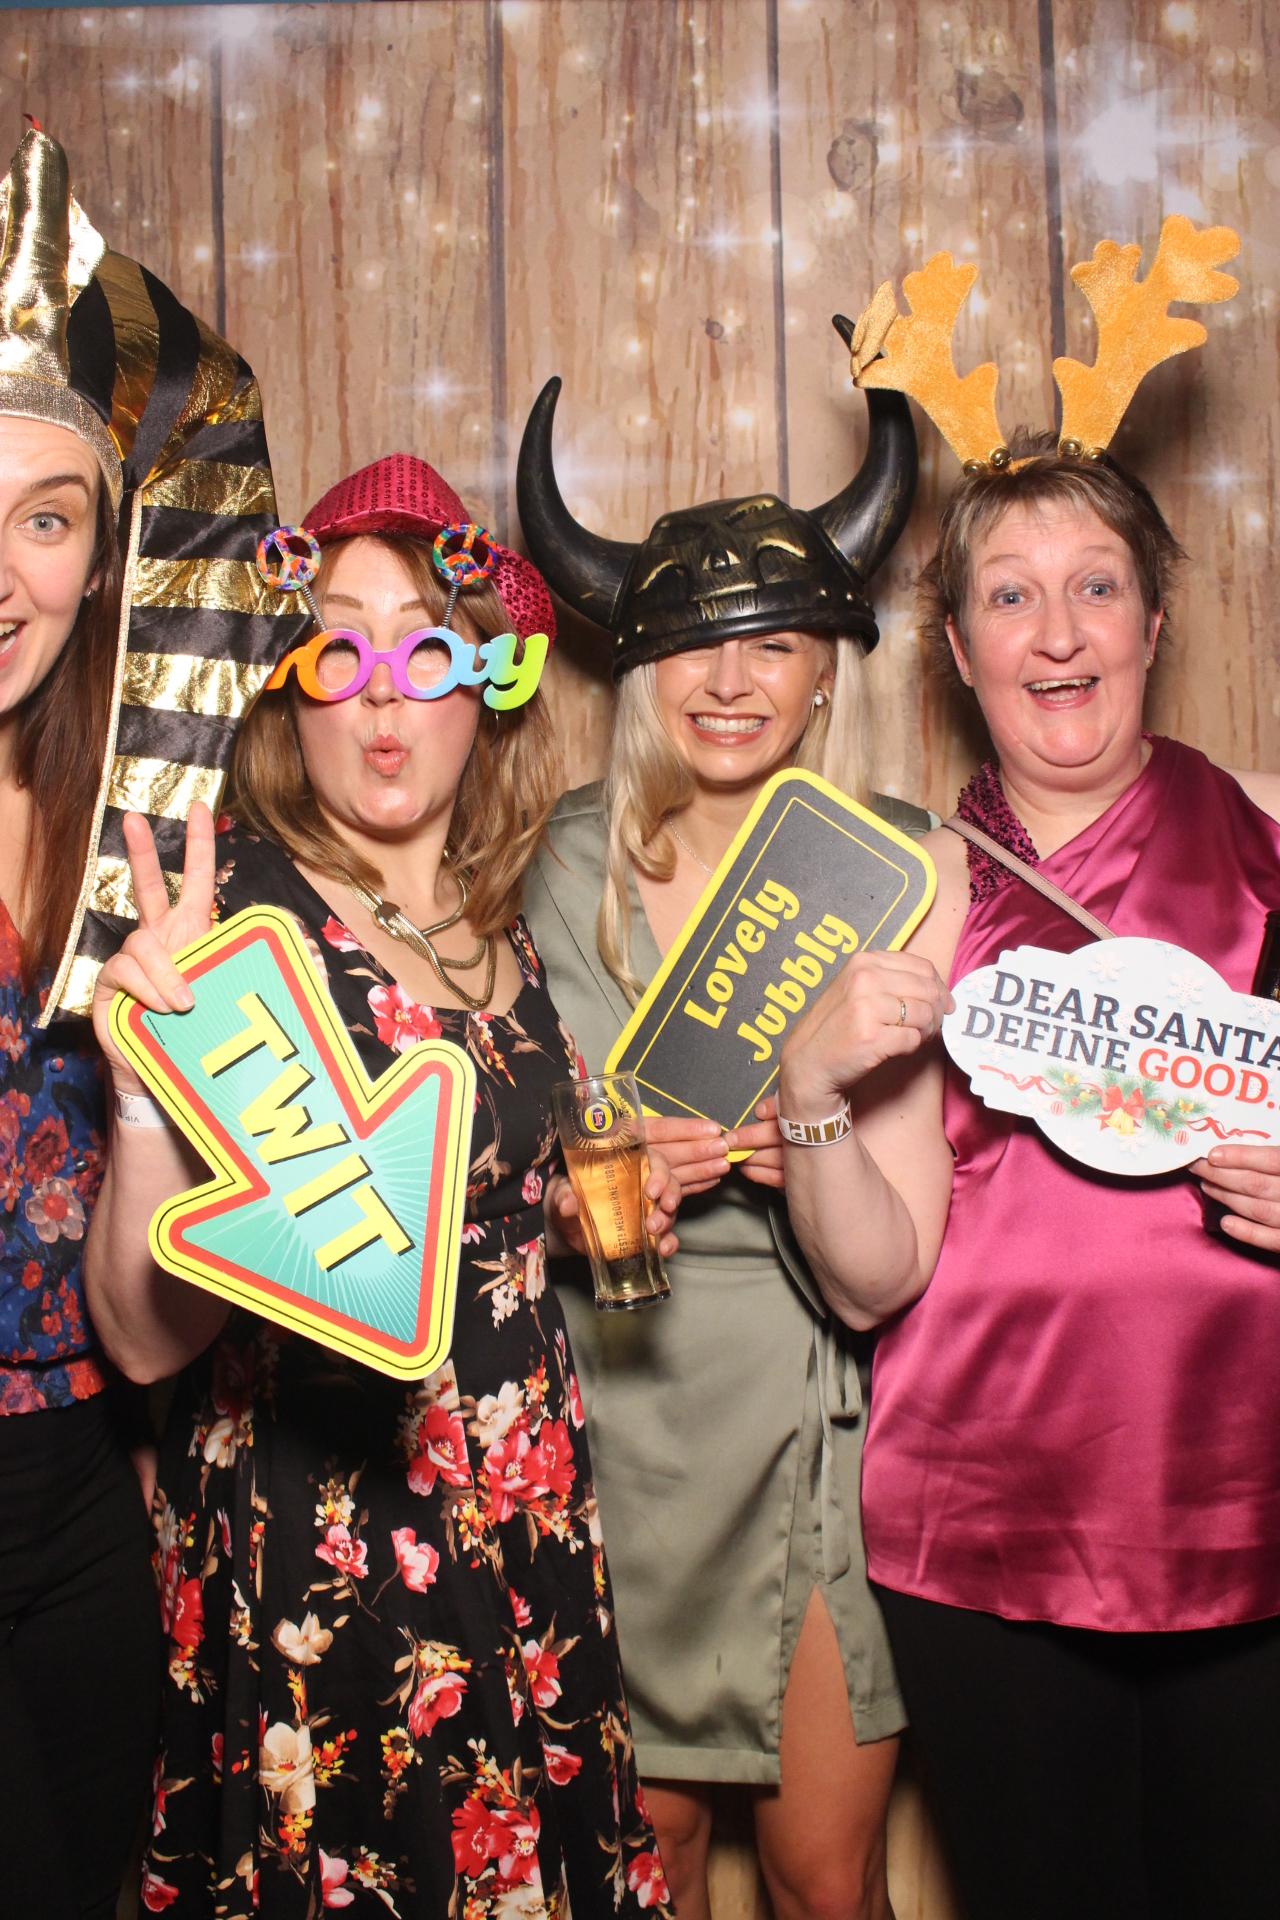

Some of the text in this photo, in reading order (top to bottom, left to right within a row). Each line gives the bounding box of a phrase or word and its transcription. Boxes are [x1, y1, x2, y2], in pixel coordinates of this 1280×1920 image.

[684, 879, 801, 1030] Lovely
[737, 913, 860, 1062] Jubbly
[961, 1004, 1131, 1074] DEFINE
[988, 970, 1280, 1071] DEAR SANTA
[199, 992, 416, 1273] TWIT
[790, 1109, 852, 1143] VIP
[608, 1185, 625, 1231] MELBOURNE
